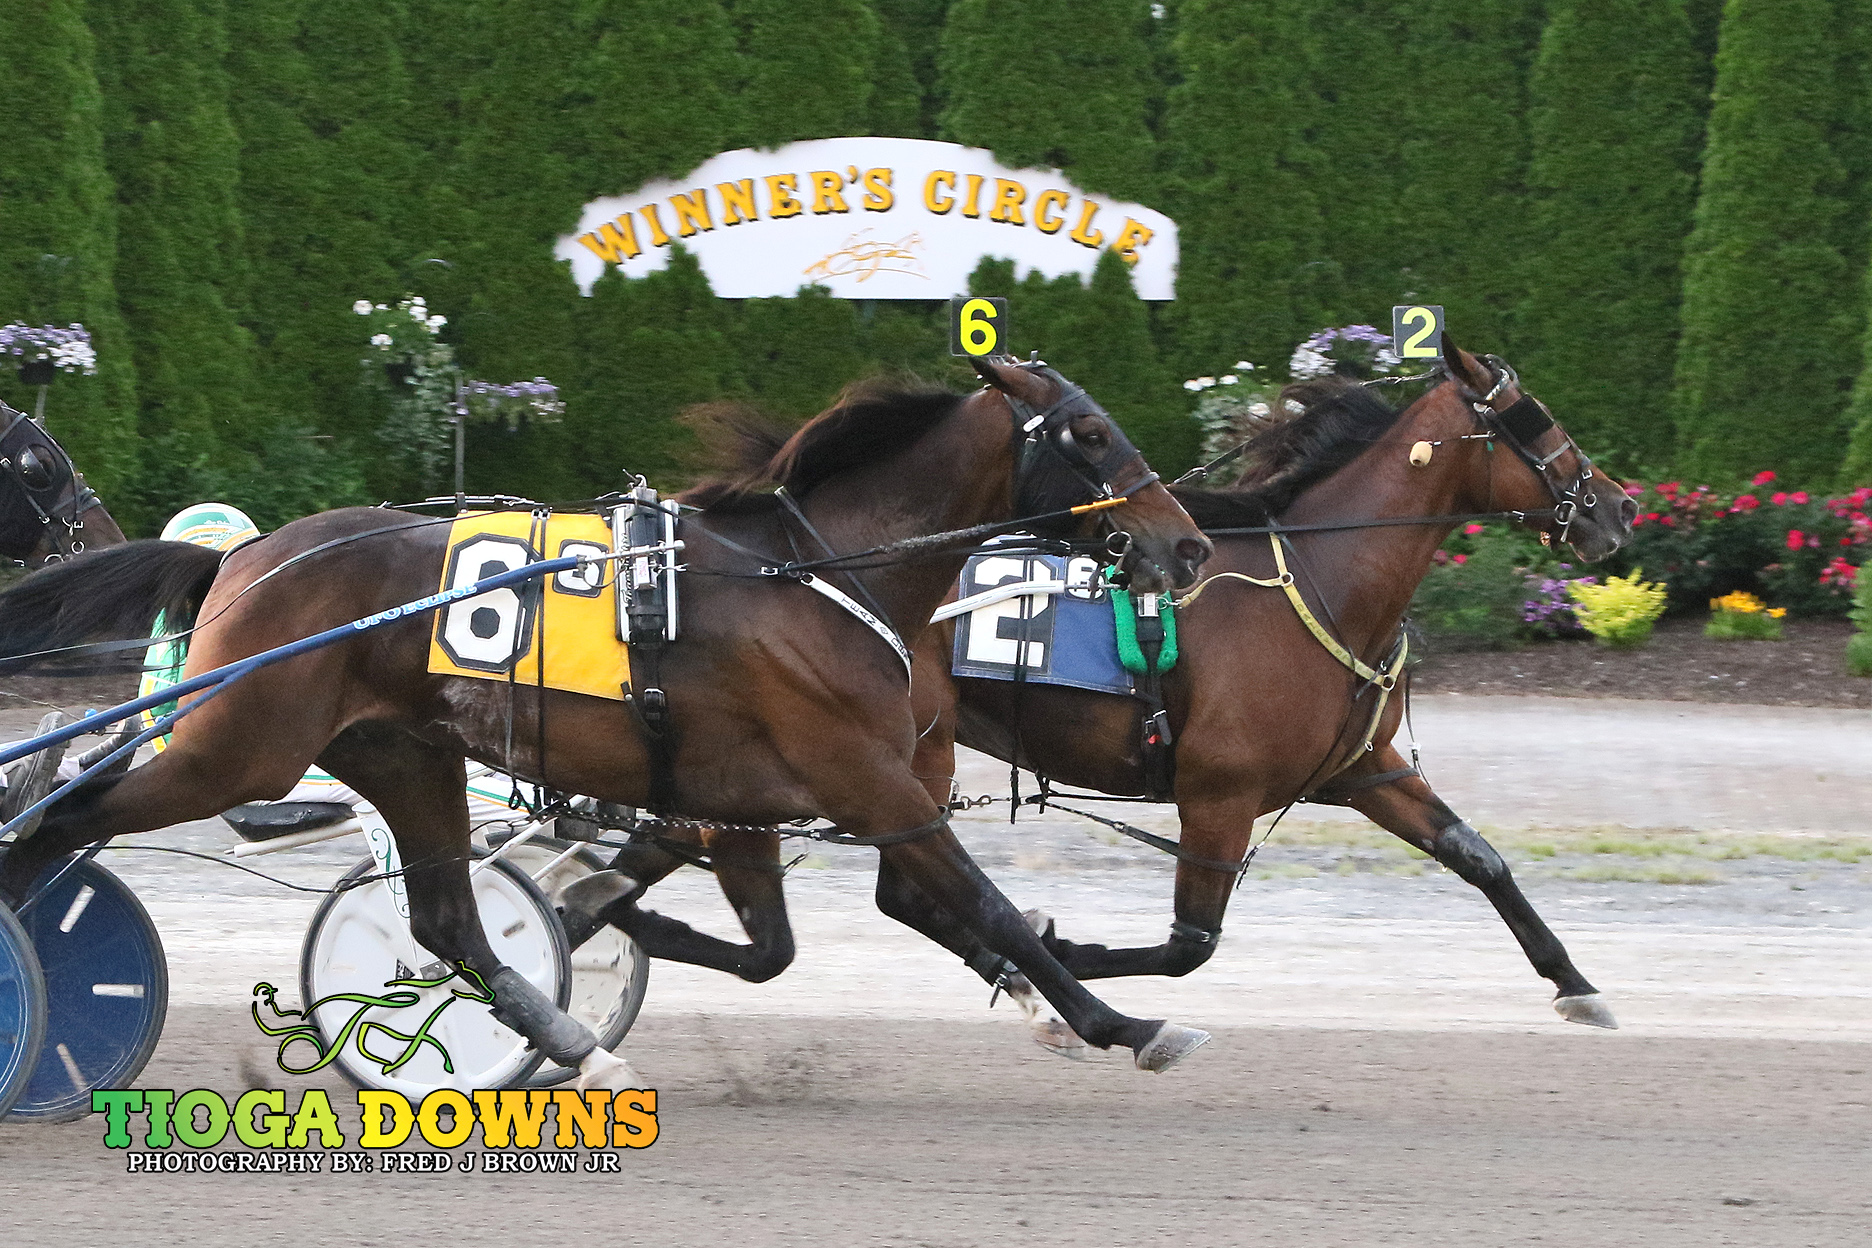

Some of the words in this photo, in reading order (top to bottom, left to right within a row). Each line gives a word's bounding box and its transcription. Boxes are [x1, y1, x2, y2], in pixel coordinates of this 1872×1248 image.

[579, 165, 894, 265] WINNER'S
[922, 169, 1155, 267] CIRCLE
[960, 298, 998, 356] 6
[1401, 306, 1438, 357] 2
[353, 606, 401, 630] UFO
[403, 584, 477, 615] ECLIPSE
[840, 597, 878, 627] TEAM
[966, 556, 1051, 668] 2
